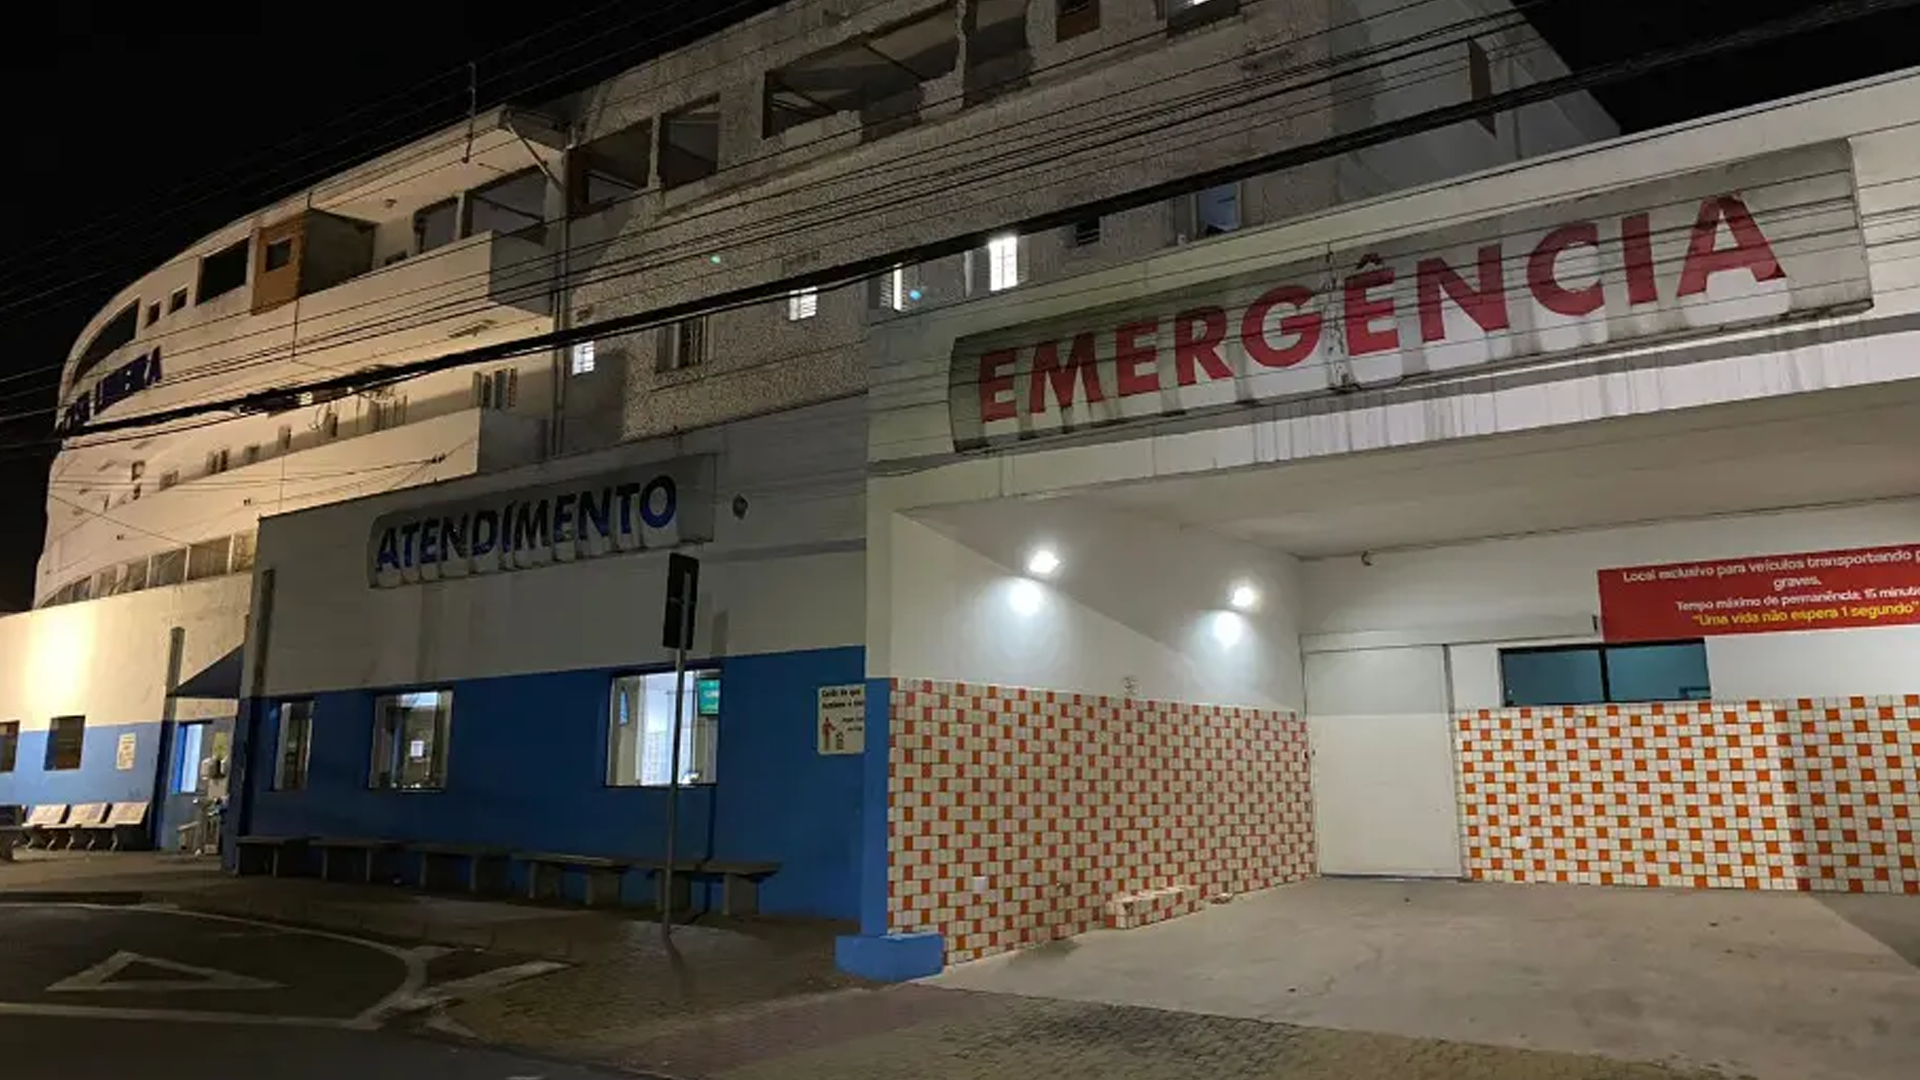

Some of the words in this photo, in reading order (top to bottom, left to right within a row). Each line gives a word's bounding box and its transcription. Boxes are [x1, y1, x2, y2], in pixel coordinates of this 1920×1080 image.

[979, 192, 1786, 423] EMERGÊNCIA
[374, 475, 677, 573] ATENDIMENTO
[1622, 570, 1656, 583] Local
[1658, 567, 1714, 580] exclusivo
[1717, 564, 1746, 578] para
[1748, 559, 1805, 573] veículos
[1807, 551, 1912, 568] transportando
[1773, 575, 1822, 591] graves.
[1675, 601, 1714, 612] Tempo
[1716, 597, 1761, 610] máximo
[1764, 596, 1780, 607] de
[1864, 588, 1877, 599] 15
[1731, 612, 1760, 623] vida
[1762, 610, 1788, 621] não
[1791, 608, 1839, 622] espera
[1841, 607, 1847, 617] 1
